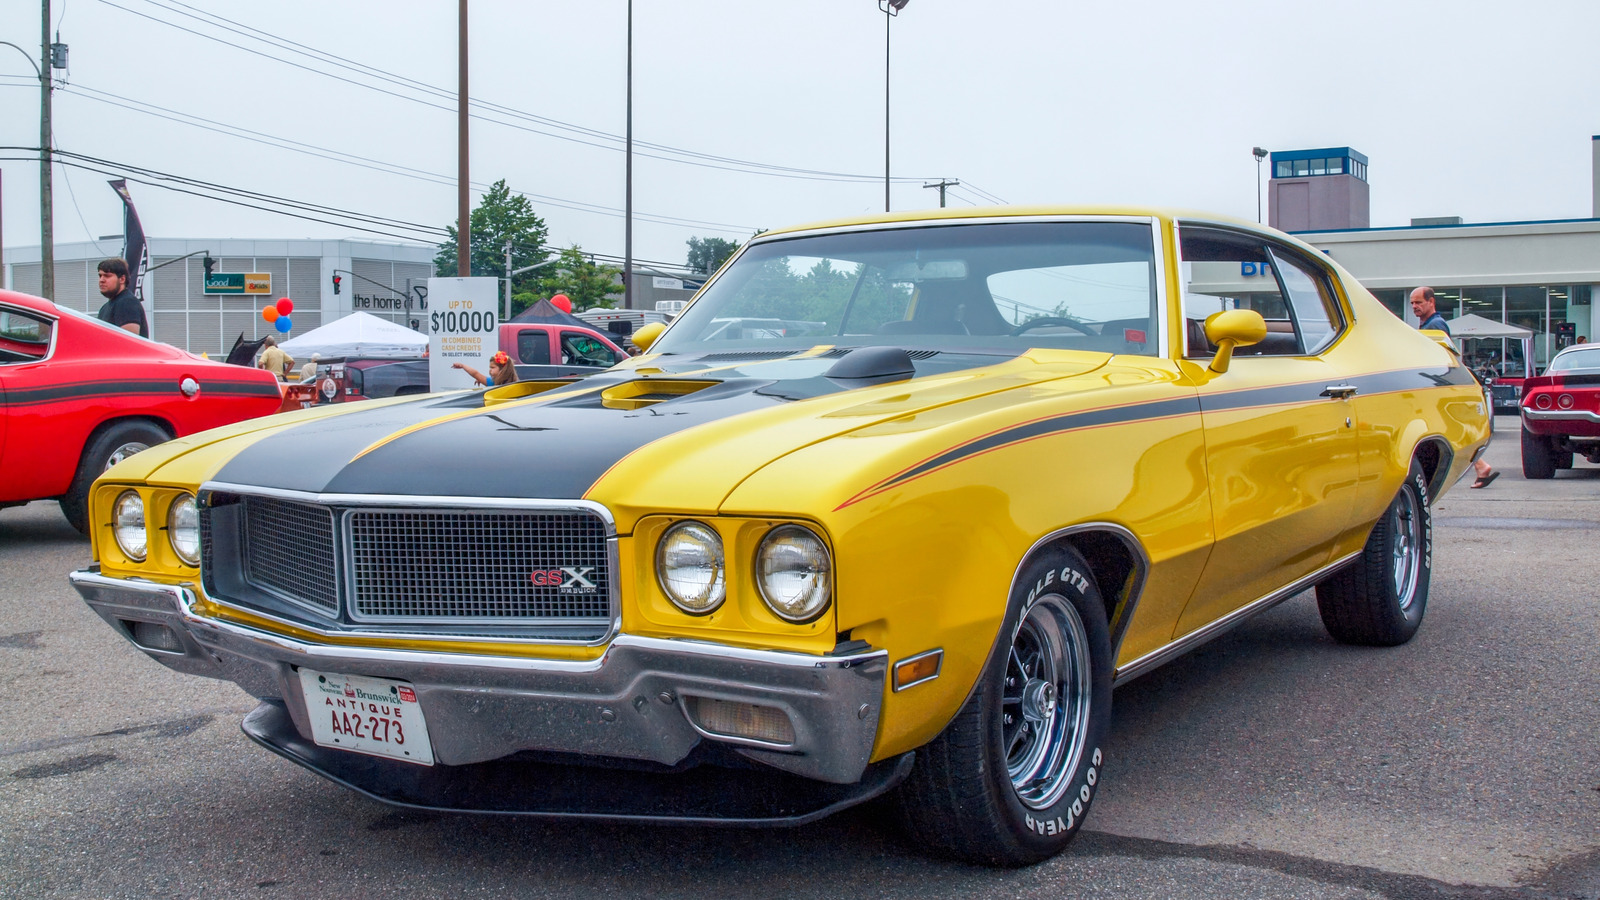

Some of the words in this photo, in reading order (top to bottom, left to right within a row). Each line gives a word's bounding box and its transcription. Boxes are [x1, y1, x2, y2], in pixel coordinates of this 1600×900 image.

[354, 294, 370, 308] the
[373, 295, 401, 309] home
[448, 300, 459, 309] UP
[462, 300, 473, 309] TO
[431, 310, 494, 335] $10,000
[531, 567, 597, 588] GSX
[319, 685, 344, 696] Nouveau
[355, 688, 402, 705] Brunswick
[328, 681, 340, 689] New
[325, 697, 402, 718] ANTIQUE
[332, 710, 404, 745] AA2-273
[1025, 747, 1102, 836] GOODYEAR
